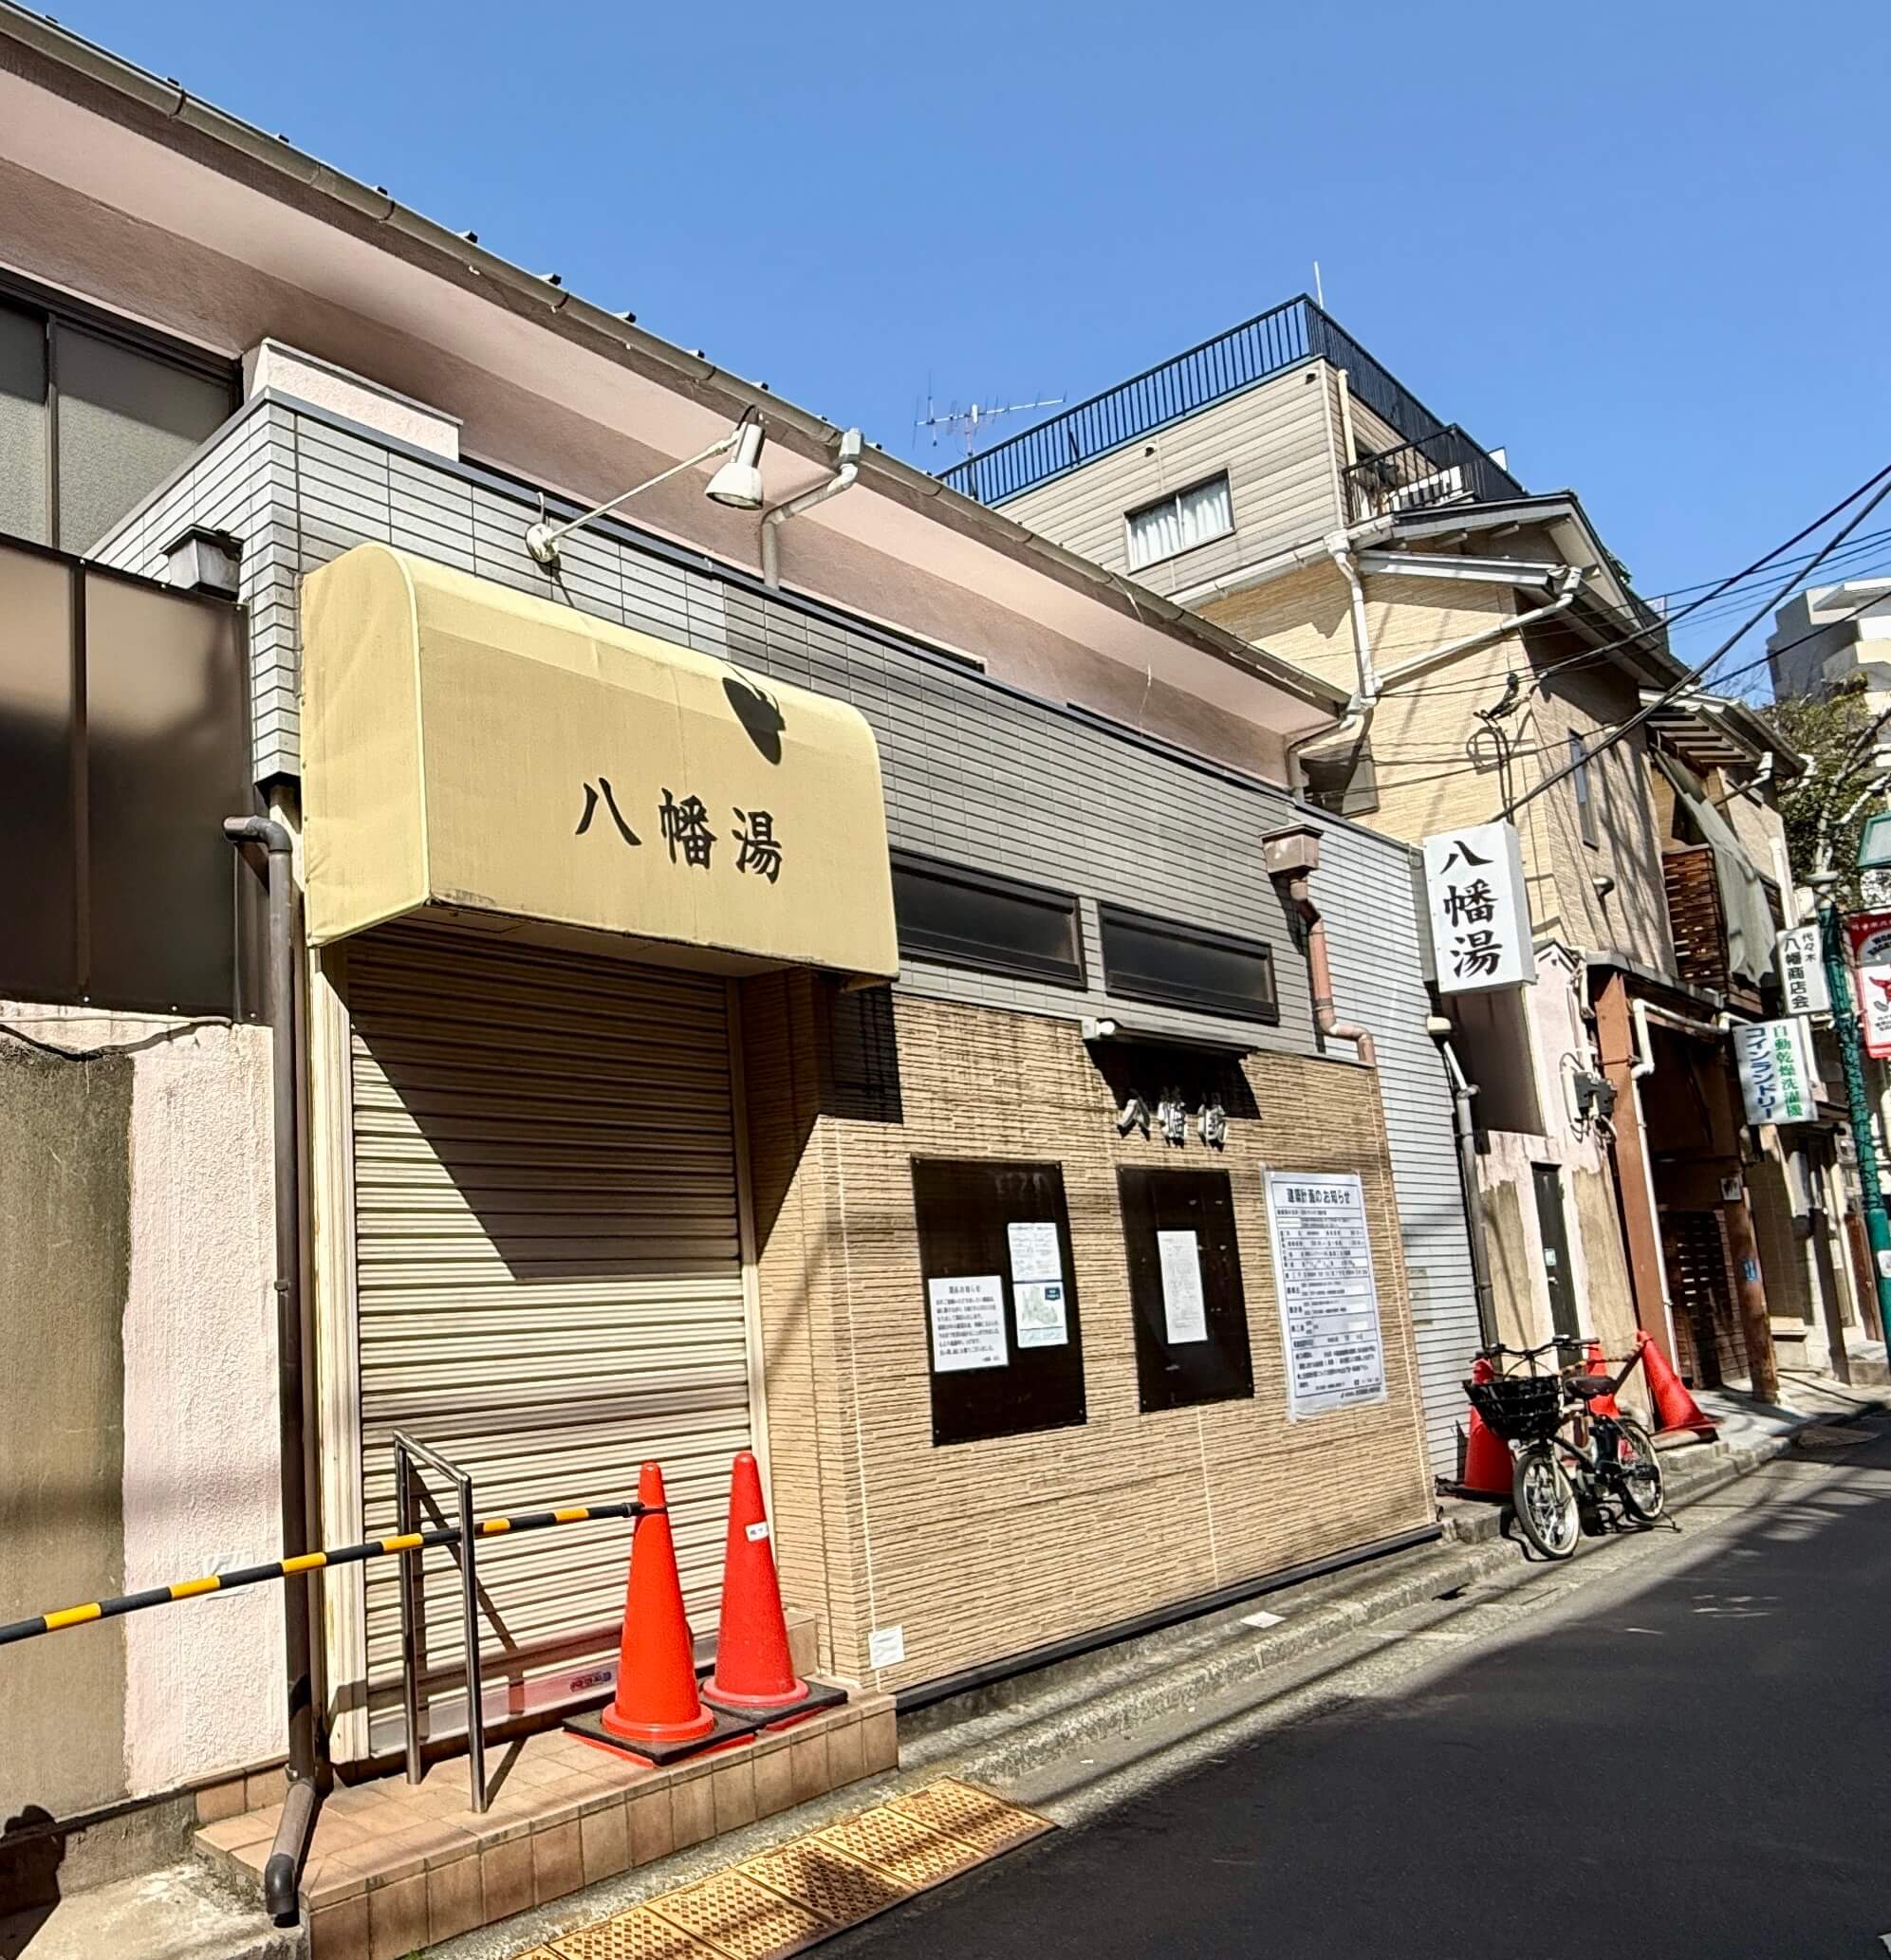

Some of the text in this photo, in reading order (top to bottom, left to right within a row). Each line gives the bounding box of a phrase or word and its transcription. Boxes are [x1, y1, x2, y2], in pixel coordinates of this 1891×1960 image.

[575, 777, 783, 884] 八幡湯
[1439, 840, 1504, 978] 八幡湯
[1802, 932, 1816, 962] 代々木
[1785, 937, 1809, 1009] 八幡商店会
[1746, 1026, 1776, 1119] コインランドリー
[1773, 1025, 1804, 1118] 自動乾燥洗濯機
